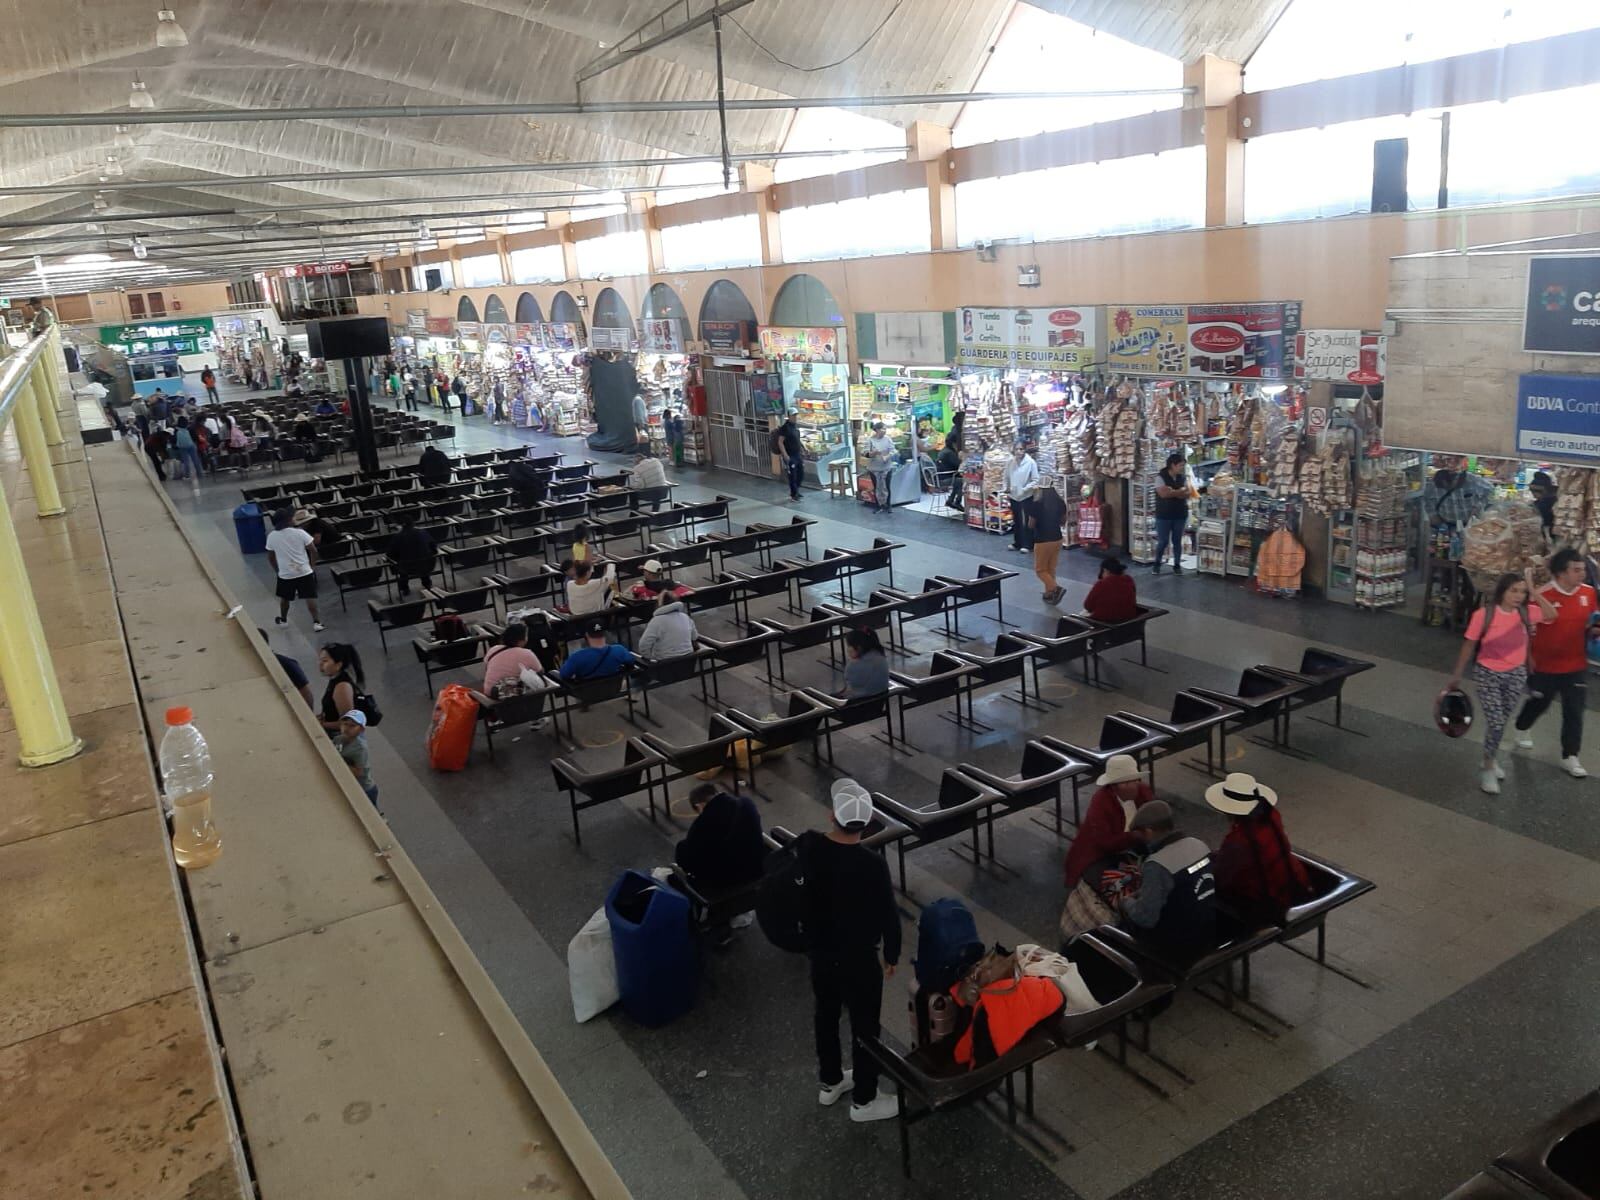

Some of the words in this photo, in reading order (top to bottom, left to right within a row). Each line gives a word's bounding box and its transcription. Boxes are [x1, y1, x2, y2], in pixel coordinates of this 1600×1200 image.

[314, 263, 346, 272] BOTICA
[1136, 308, 1184, 316] COMERCIAL
[960, 348, 1008, 360] GUARDERIA
[1011, 350, 1022, 360] DE
[1025, 351, 1078, 362] EQUIPAJES
[1527, 396, 1564, 411] BBVA
[1530, 437, 1565, 448] cajero
